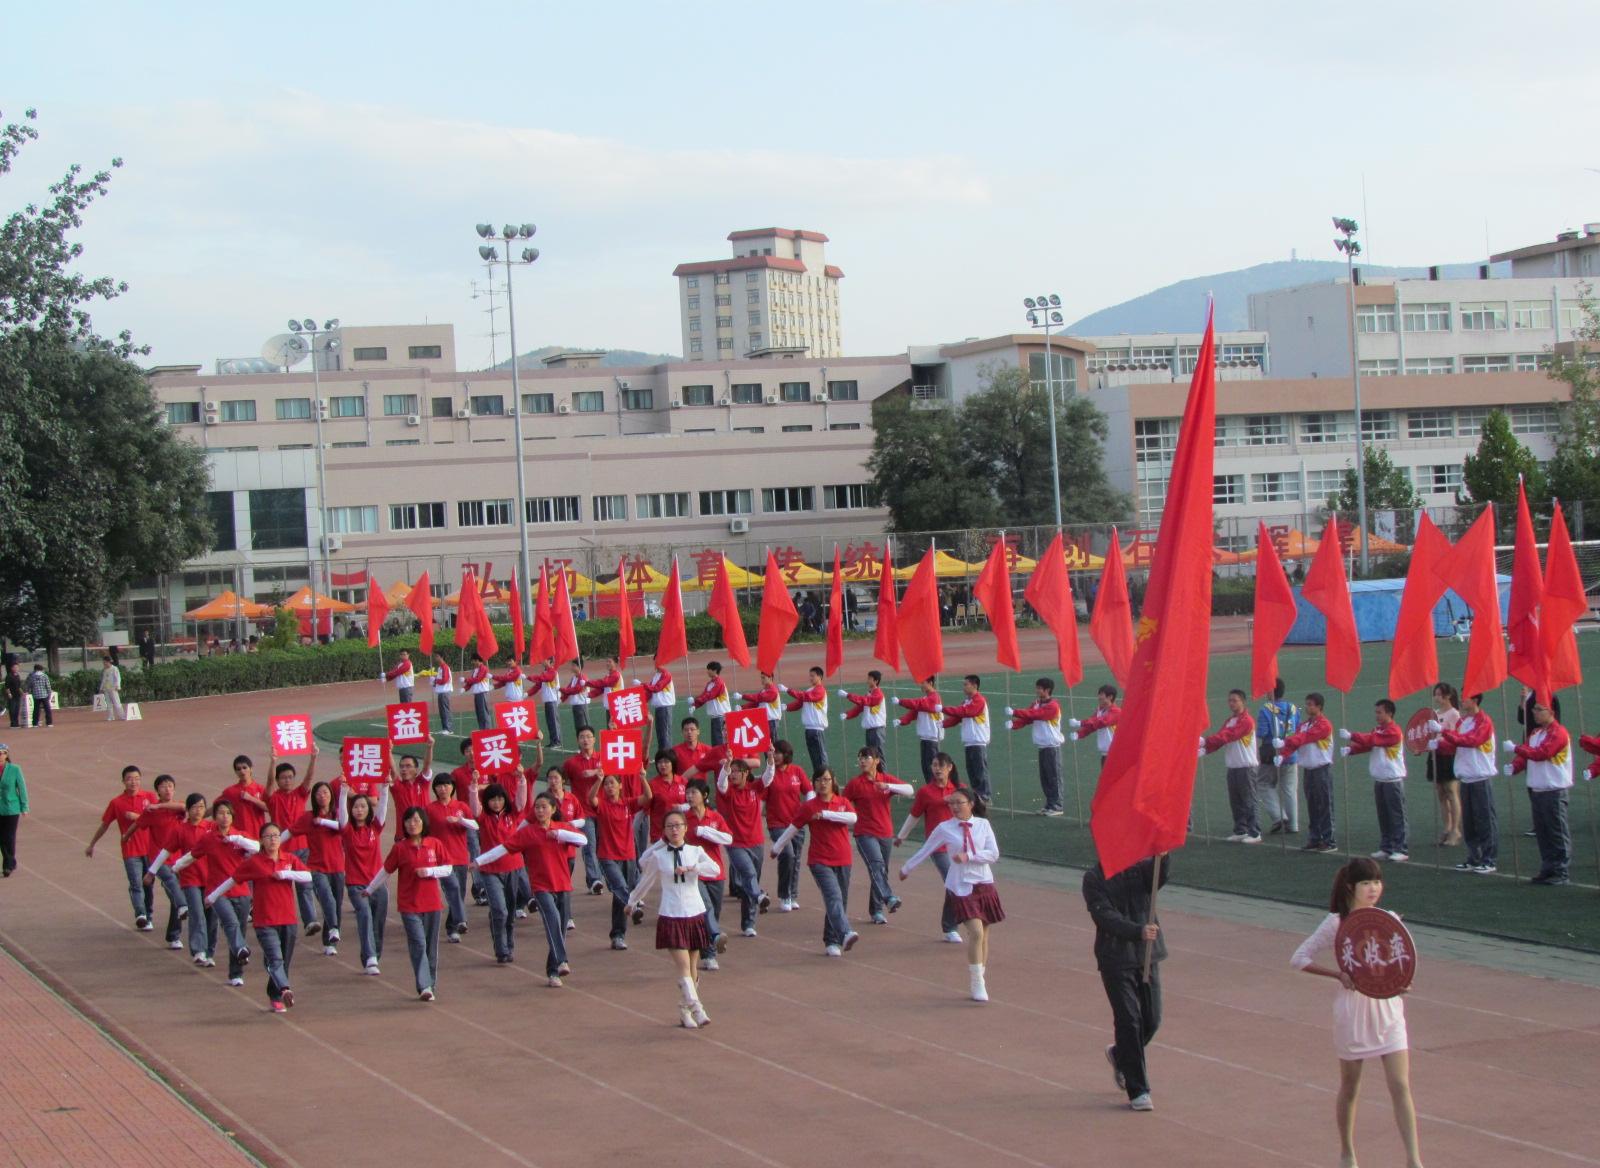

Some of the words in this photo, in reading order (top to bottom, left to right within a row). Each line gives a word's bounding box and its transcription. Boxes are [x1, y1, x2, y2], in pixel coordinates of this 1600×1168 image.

[393, 708, 424, 740] 益
[503, 706, 532, 737] 求
[614, 692, 643, 725] 精
[276, 719, 308, 750] 精
[733, 717, 765, 748] 心
[349, 744, 384, 777] 提
[480, 734, 513, 769] 采
[607, 735, 635, 769] 中
